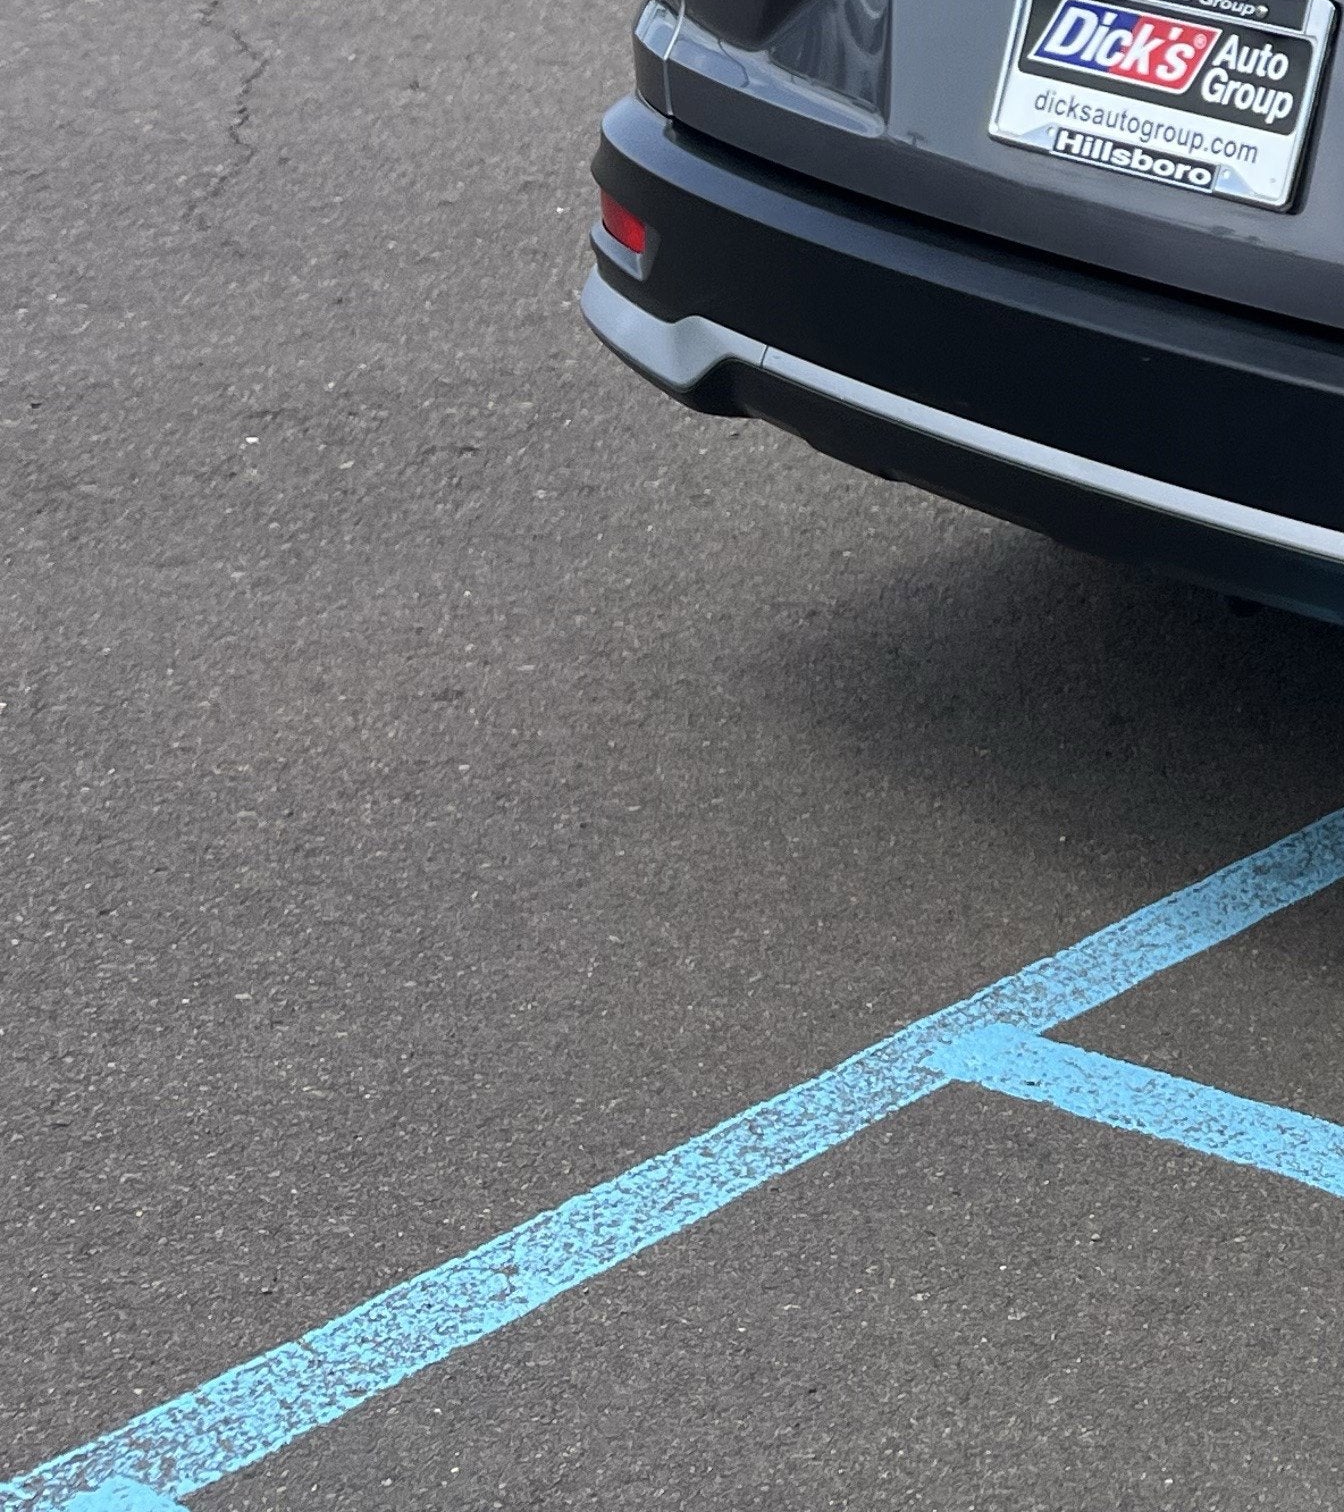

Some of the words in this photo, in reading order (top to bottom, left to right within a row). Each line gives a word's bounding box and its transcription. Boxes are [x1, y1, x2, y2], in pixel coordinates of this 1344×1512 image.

[1043, 5, 1196, 82] Dick's
[1211, 33, 1289, 81] Auto
[1034, 89, 1258, 164] dicksautogroup.com
[1201, 66, 1294, 125] Group
[1053, 129, 1213, 186] Hillsboro
